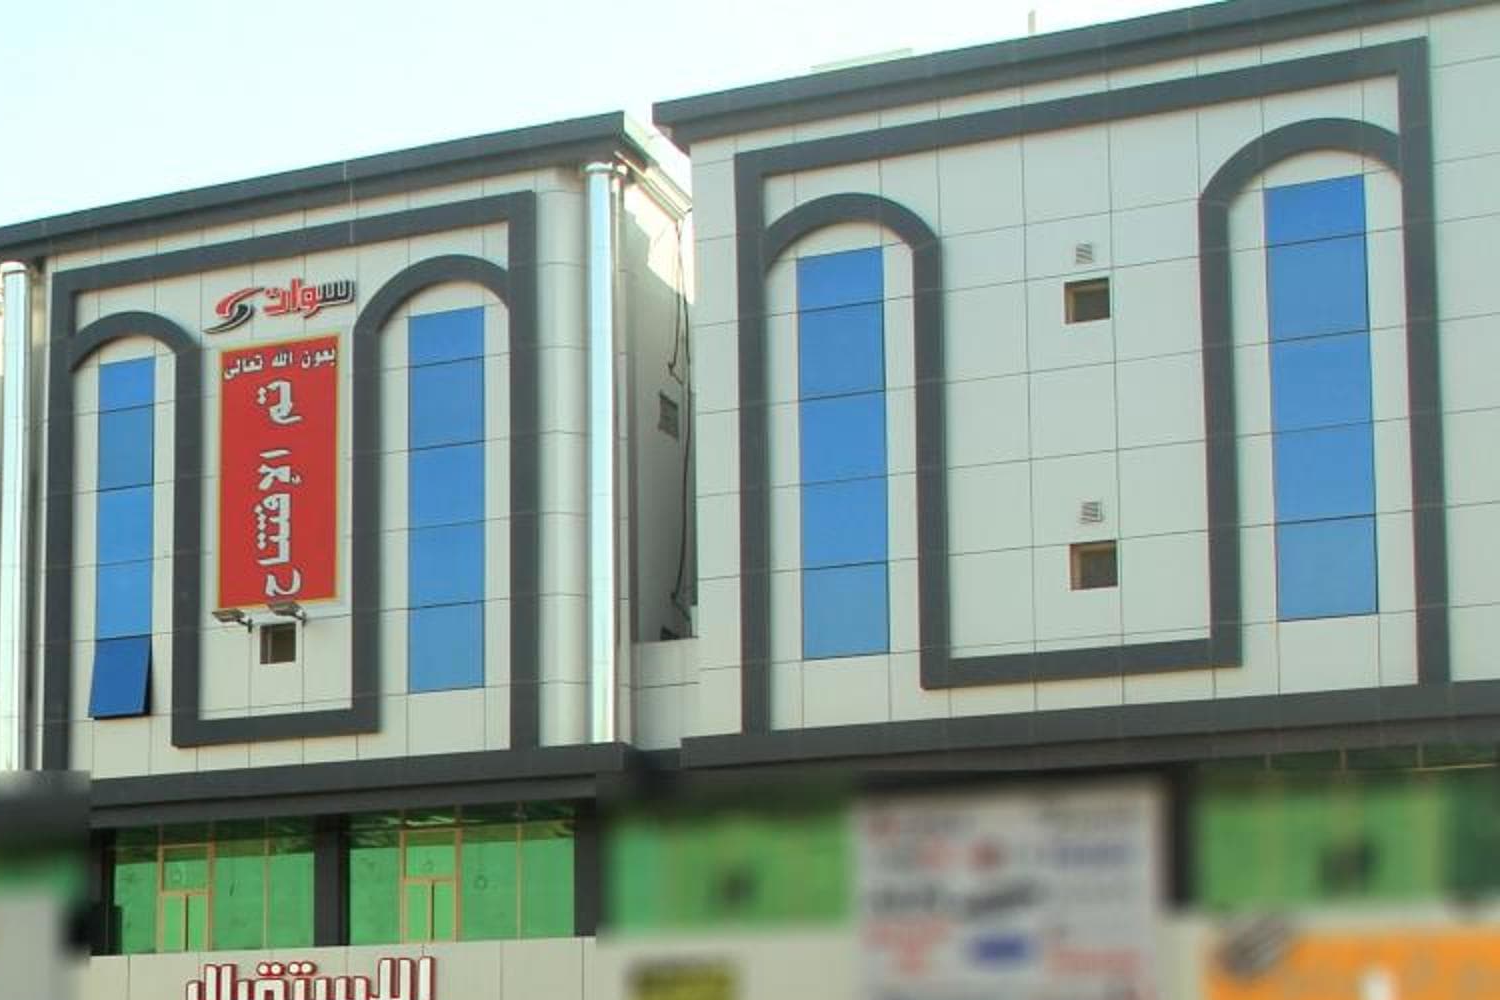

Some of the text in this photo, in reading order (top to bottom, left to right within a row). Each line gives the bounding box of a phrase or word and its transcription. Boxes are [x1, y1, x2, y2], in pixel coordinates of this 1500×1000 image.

[223, 345, 337, 380] بعون الله تعالى
[254, 379, 303, 597] تم الإفتتاح
